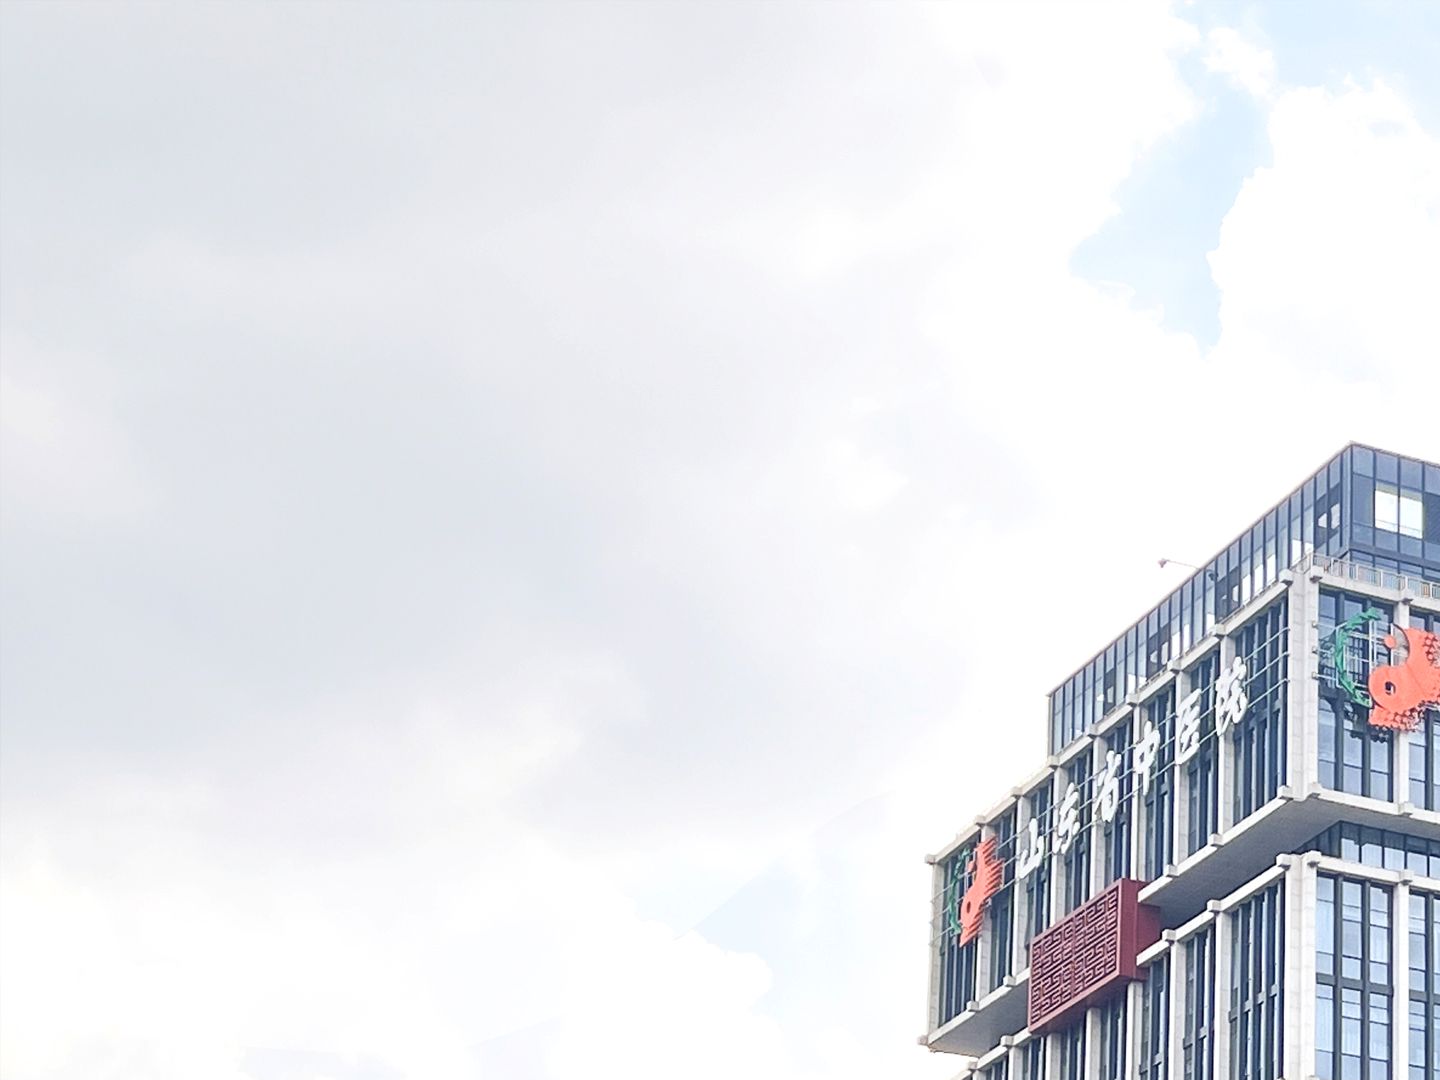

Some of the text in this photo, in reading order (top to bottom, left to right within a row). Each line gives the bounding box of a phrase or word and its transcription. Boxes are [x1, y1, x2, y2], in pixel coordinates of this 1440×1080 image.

[1018, 656, 1249, 880] 山东省中医院
